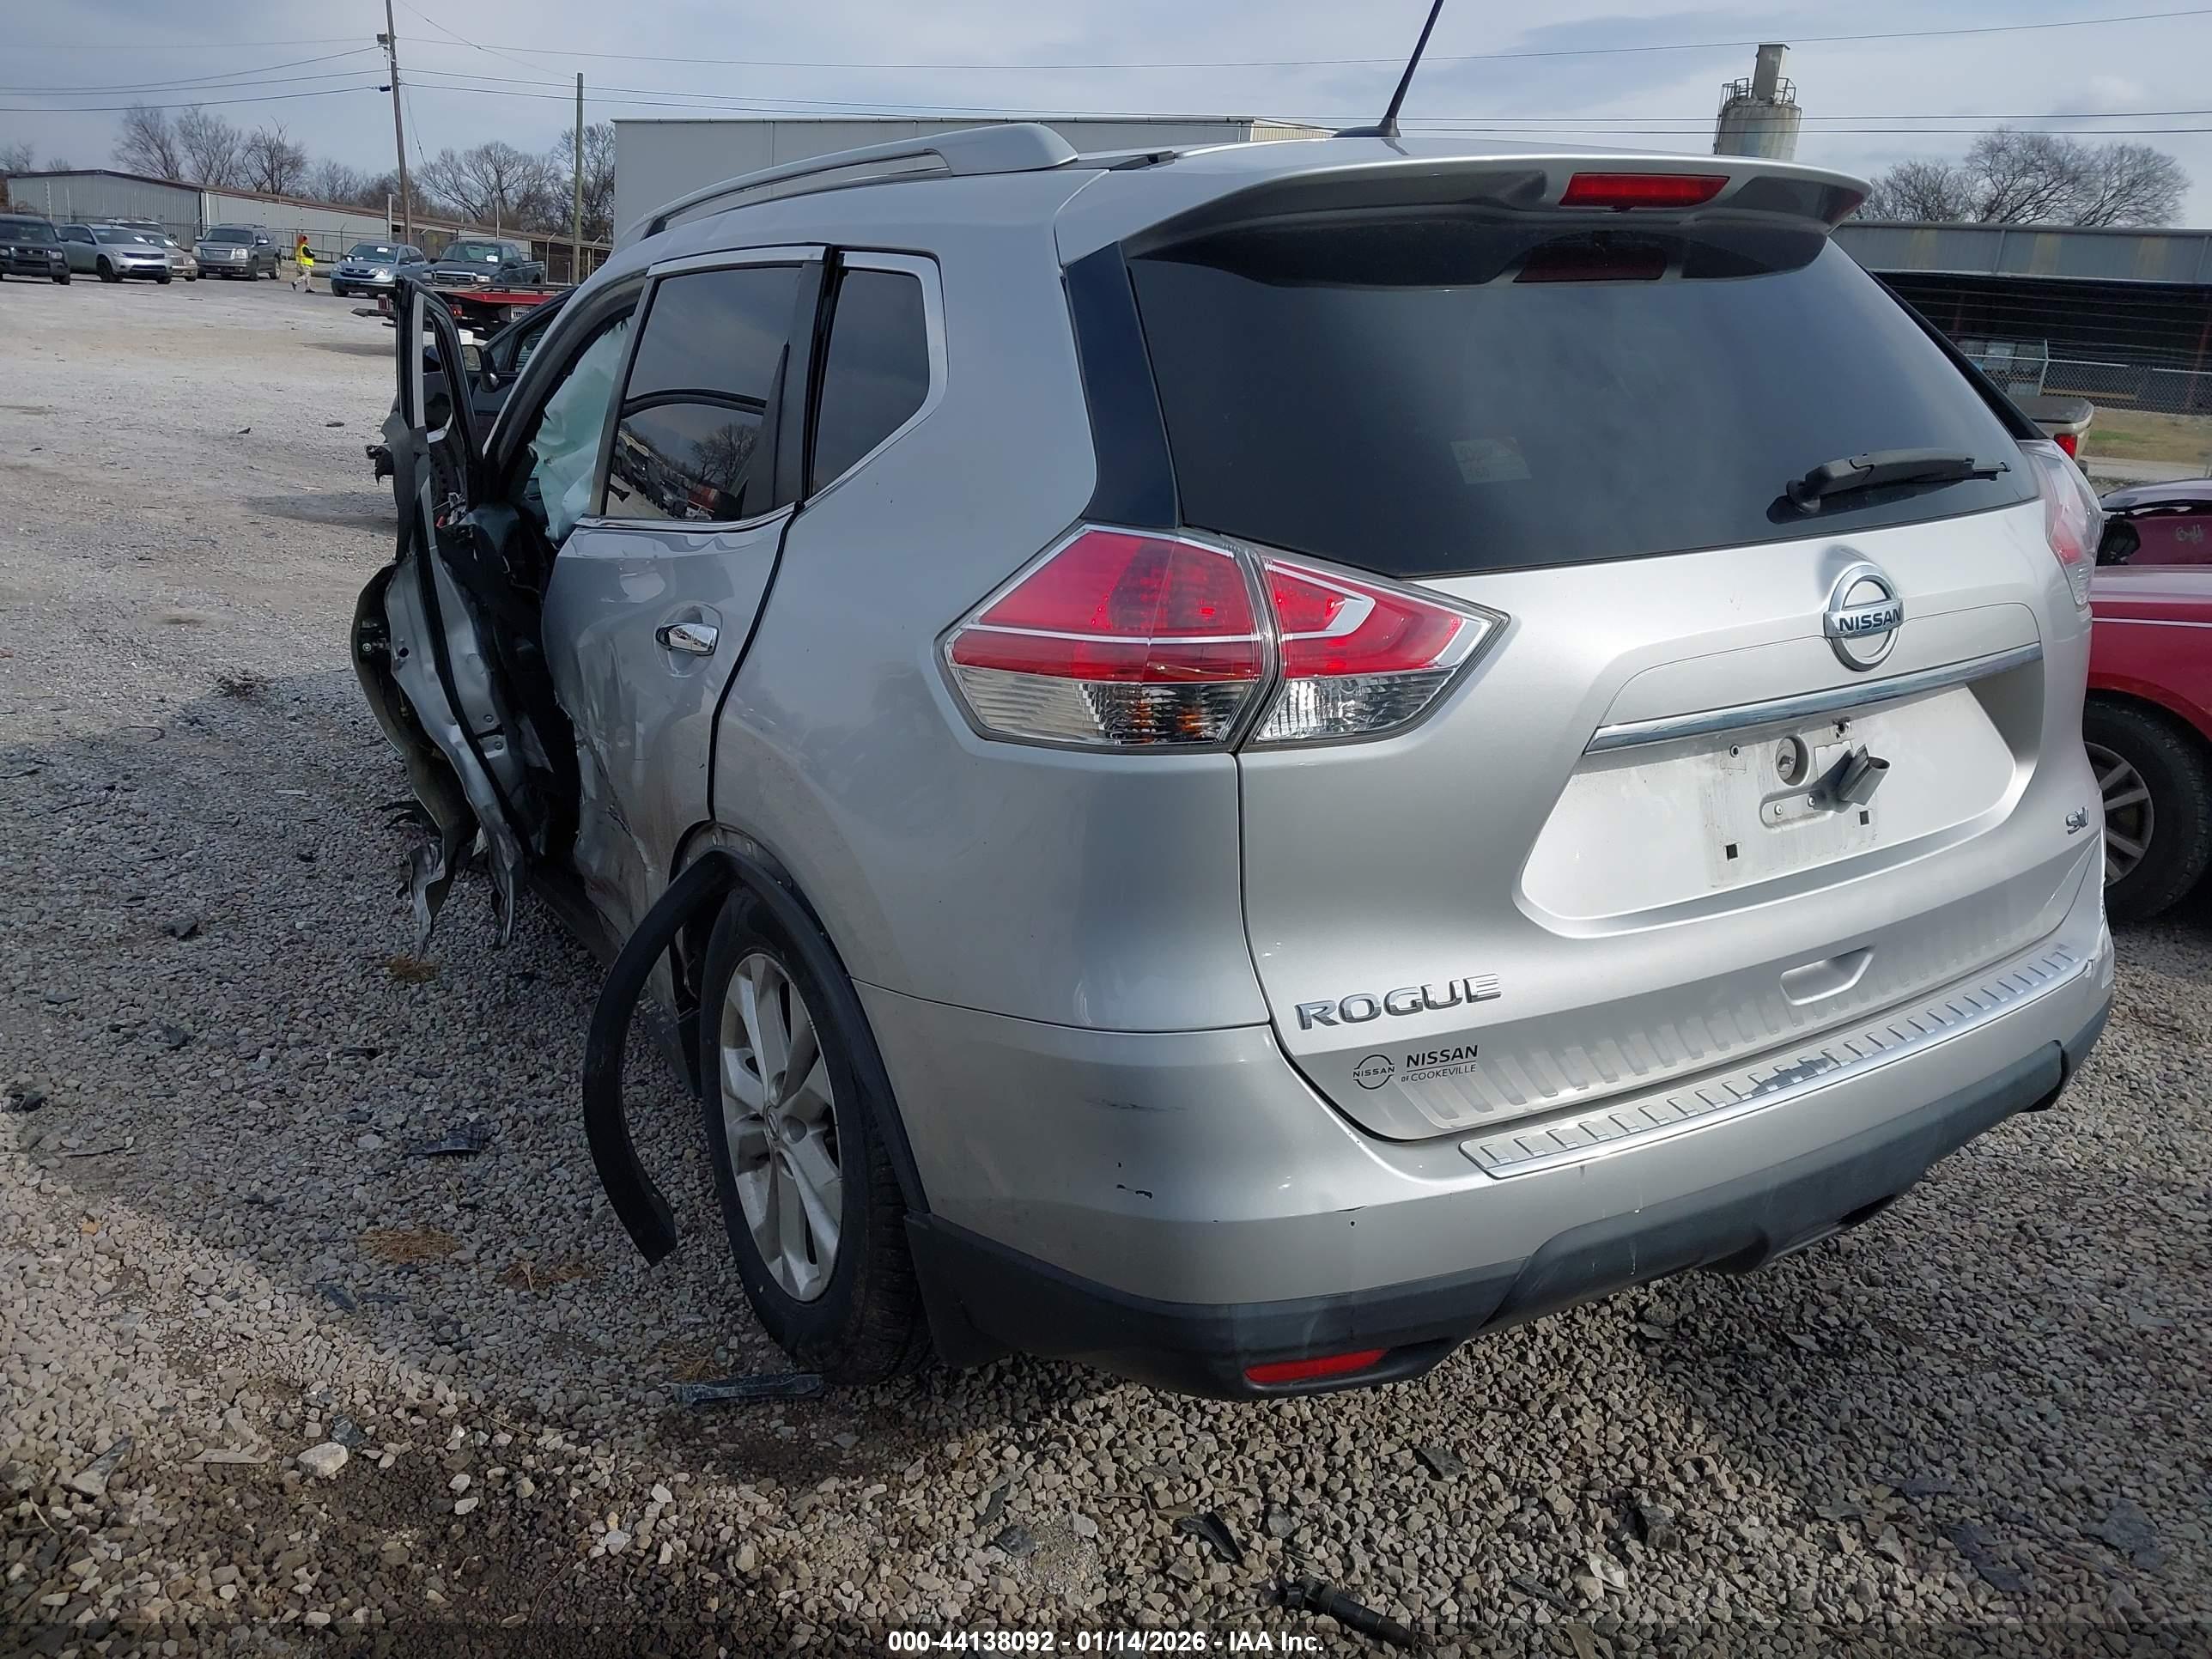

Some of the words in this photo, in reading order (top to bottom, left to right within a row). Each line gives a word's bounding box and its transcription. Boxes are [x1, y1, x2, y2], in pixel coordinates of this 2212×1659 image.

[1839, 607, 1902, 632] NISSAN
[1294, 973, 1502, 1030] ROGUE
[1406, 1044, 1479, 1068] NISSAN
[1352, 1066, 1395, 1079] NISSAN
[1410, 1063, 1477, 1082] COOKEVILLE
